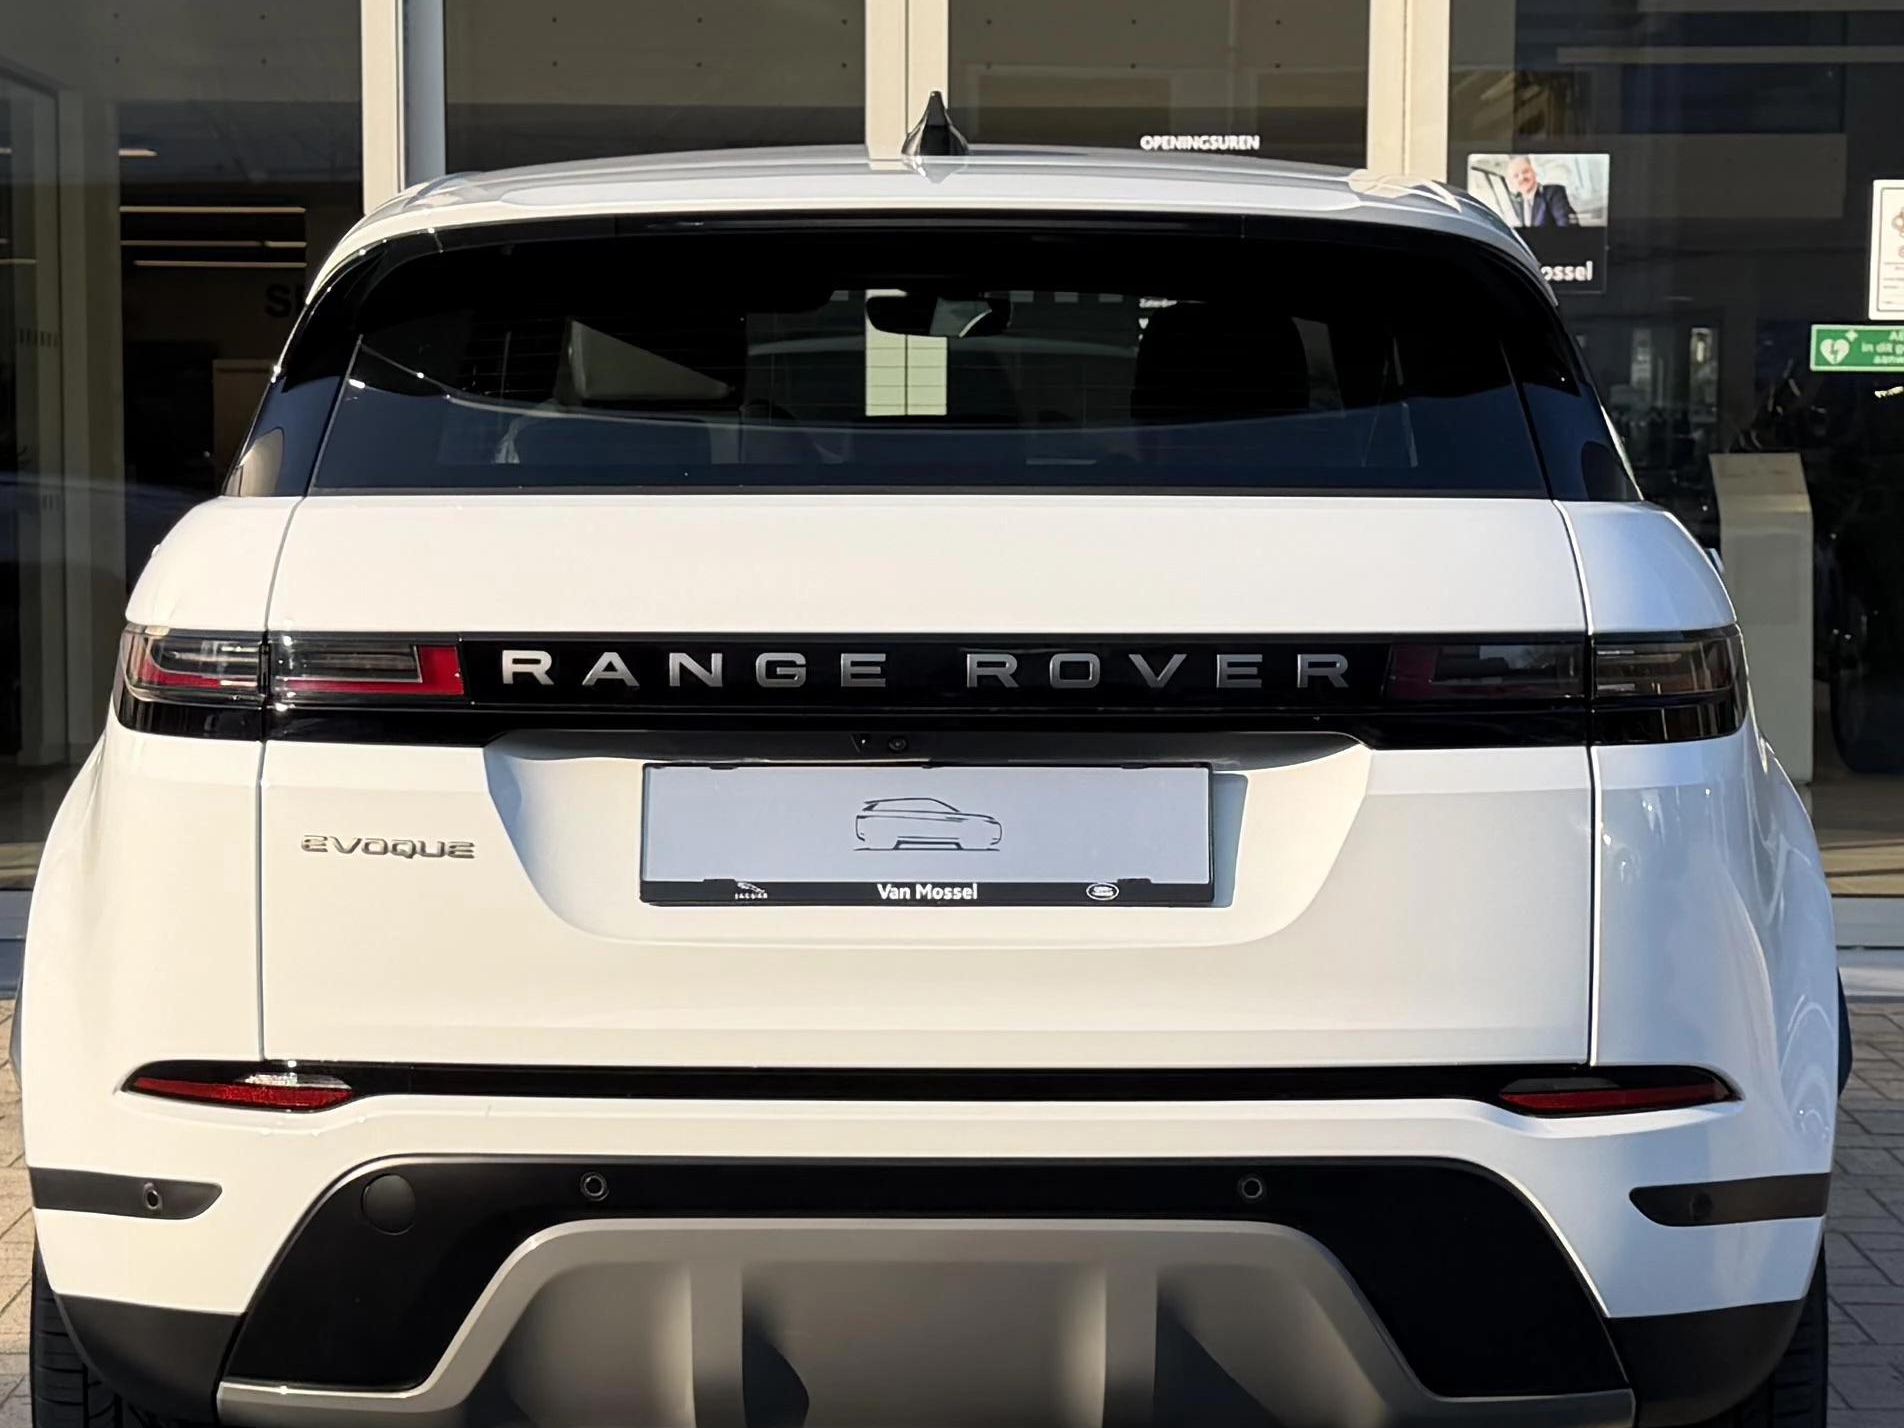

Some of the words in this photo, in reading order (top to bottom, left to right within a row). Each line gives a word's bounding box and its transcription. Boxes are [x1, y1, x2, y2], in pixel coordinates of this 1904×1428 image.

[1140, 135, 1260, 150] OPENINGSUREN
[1540, 260, 1594, 281] ossel
[500, 650, 888, 689] RANGE
[966, 652, 1350, 690] ROVER
[301, 835, 475, 859] EVOQUE
[877, 883, 911, 900] Van
[916, 883, 978, 900] Mossel
